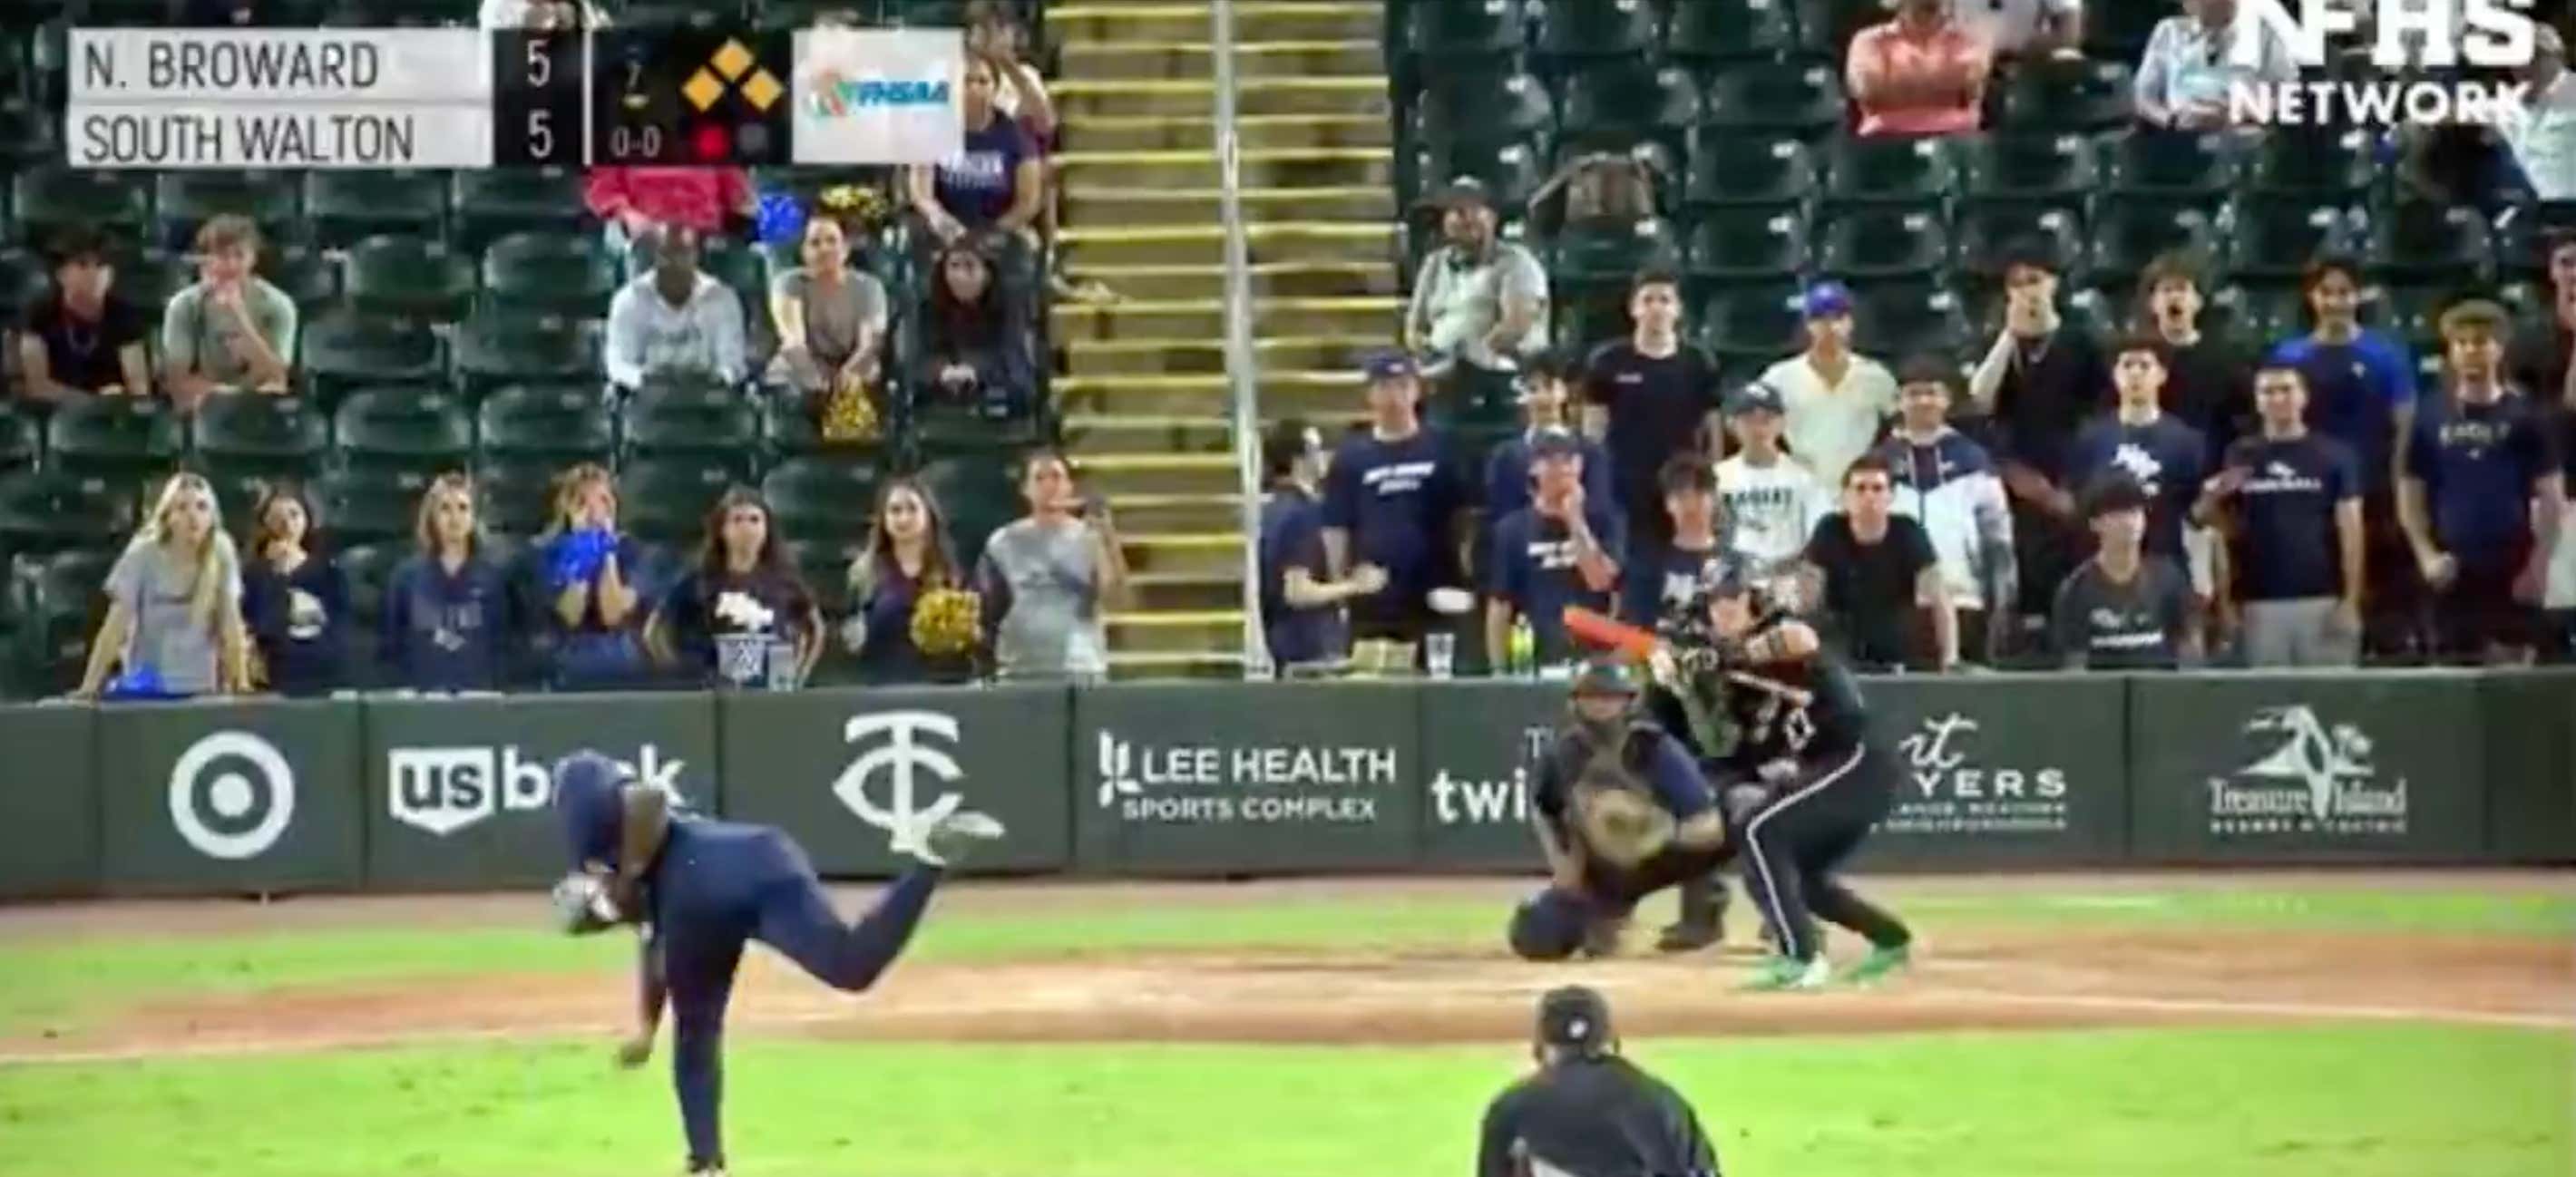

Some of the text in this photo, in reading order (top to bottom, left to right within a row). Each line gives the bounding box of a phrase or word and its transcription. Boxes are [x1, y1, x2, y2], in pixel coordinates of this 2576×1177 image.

[503, 744, 686, 810] bk
[1143, 748, 1396, 783] LEE HEALTH
[1912, 768, 2067, 798] YERS
[1122, 797, 1376, 821] SPORTS COMPLEX
[1431, 767, 1527, 823] twi
